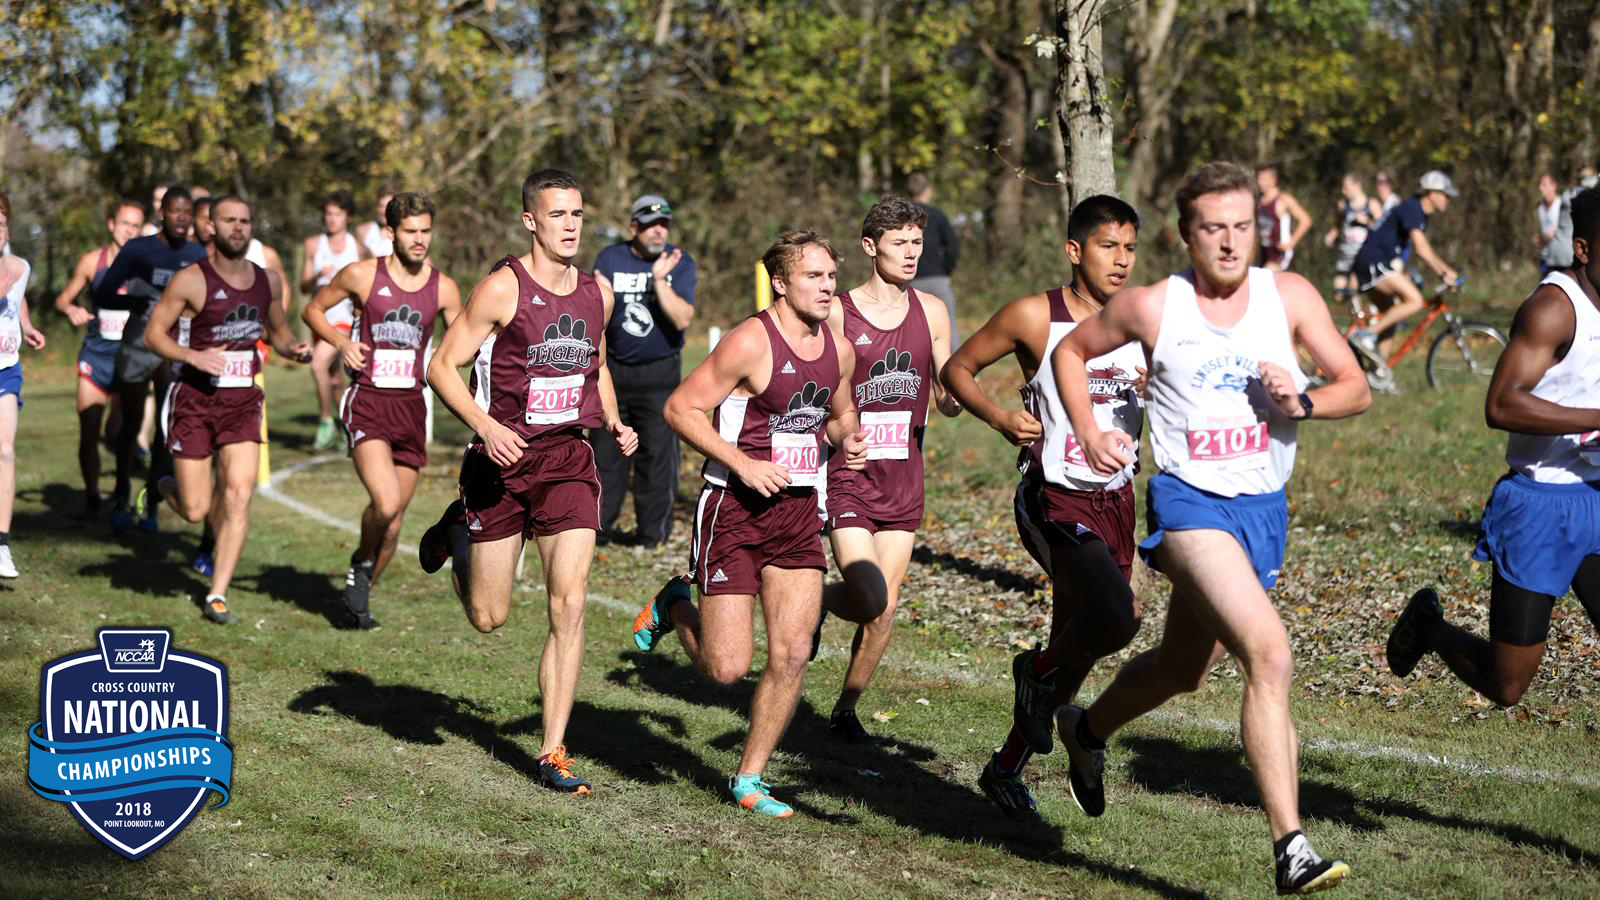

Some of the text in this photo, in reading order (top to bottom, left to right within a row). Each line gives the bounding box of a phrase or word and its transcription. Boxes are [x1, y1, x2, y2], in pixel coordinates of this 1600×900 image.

[224, 361, 252, 376] 018
[374, 360, 416, 376] 2017
[1191, 355, 1263, 389] LINDSEY WILS
[530, 387, 580, 410] 2015
[856, 377, 921, 408] TIGERS
[864, 424, 909, 445] 2014
[1193, 424, 1263, 456] 2101
[776, 447, 818, 470] 2010
